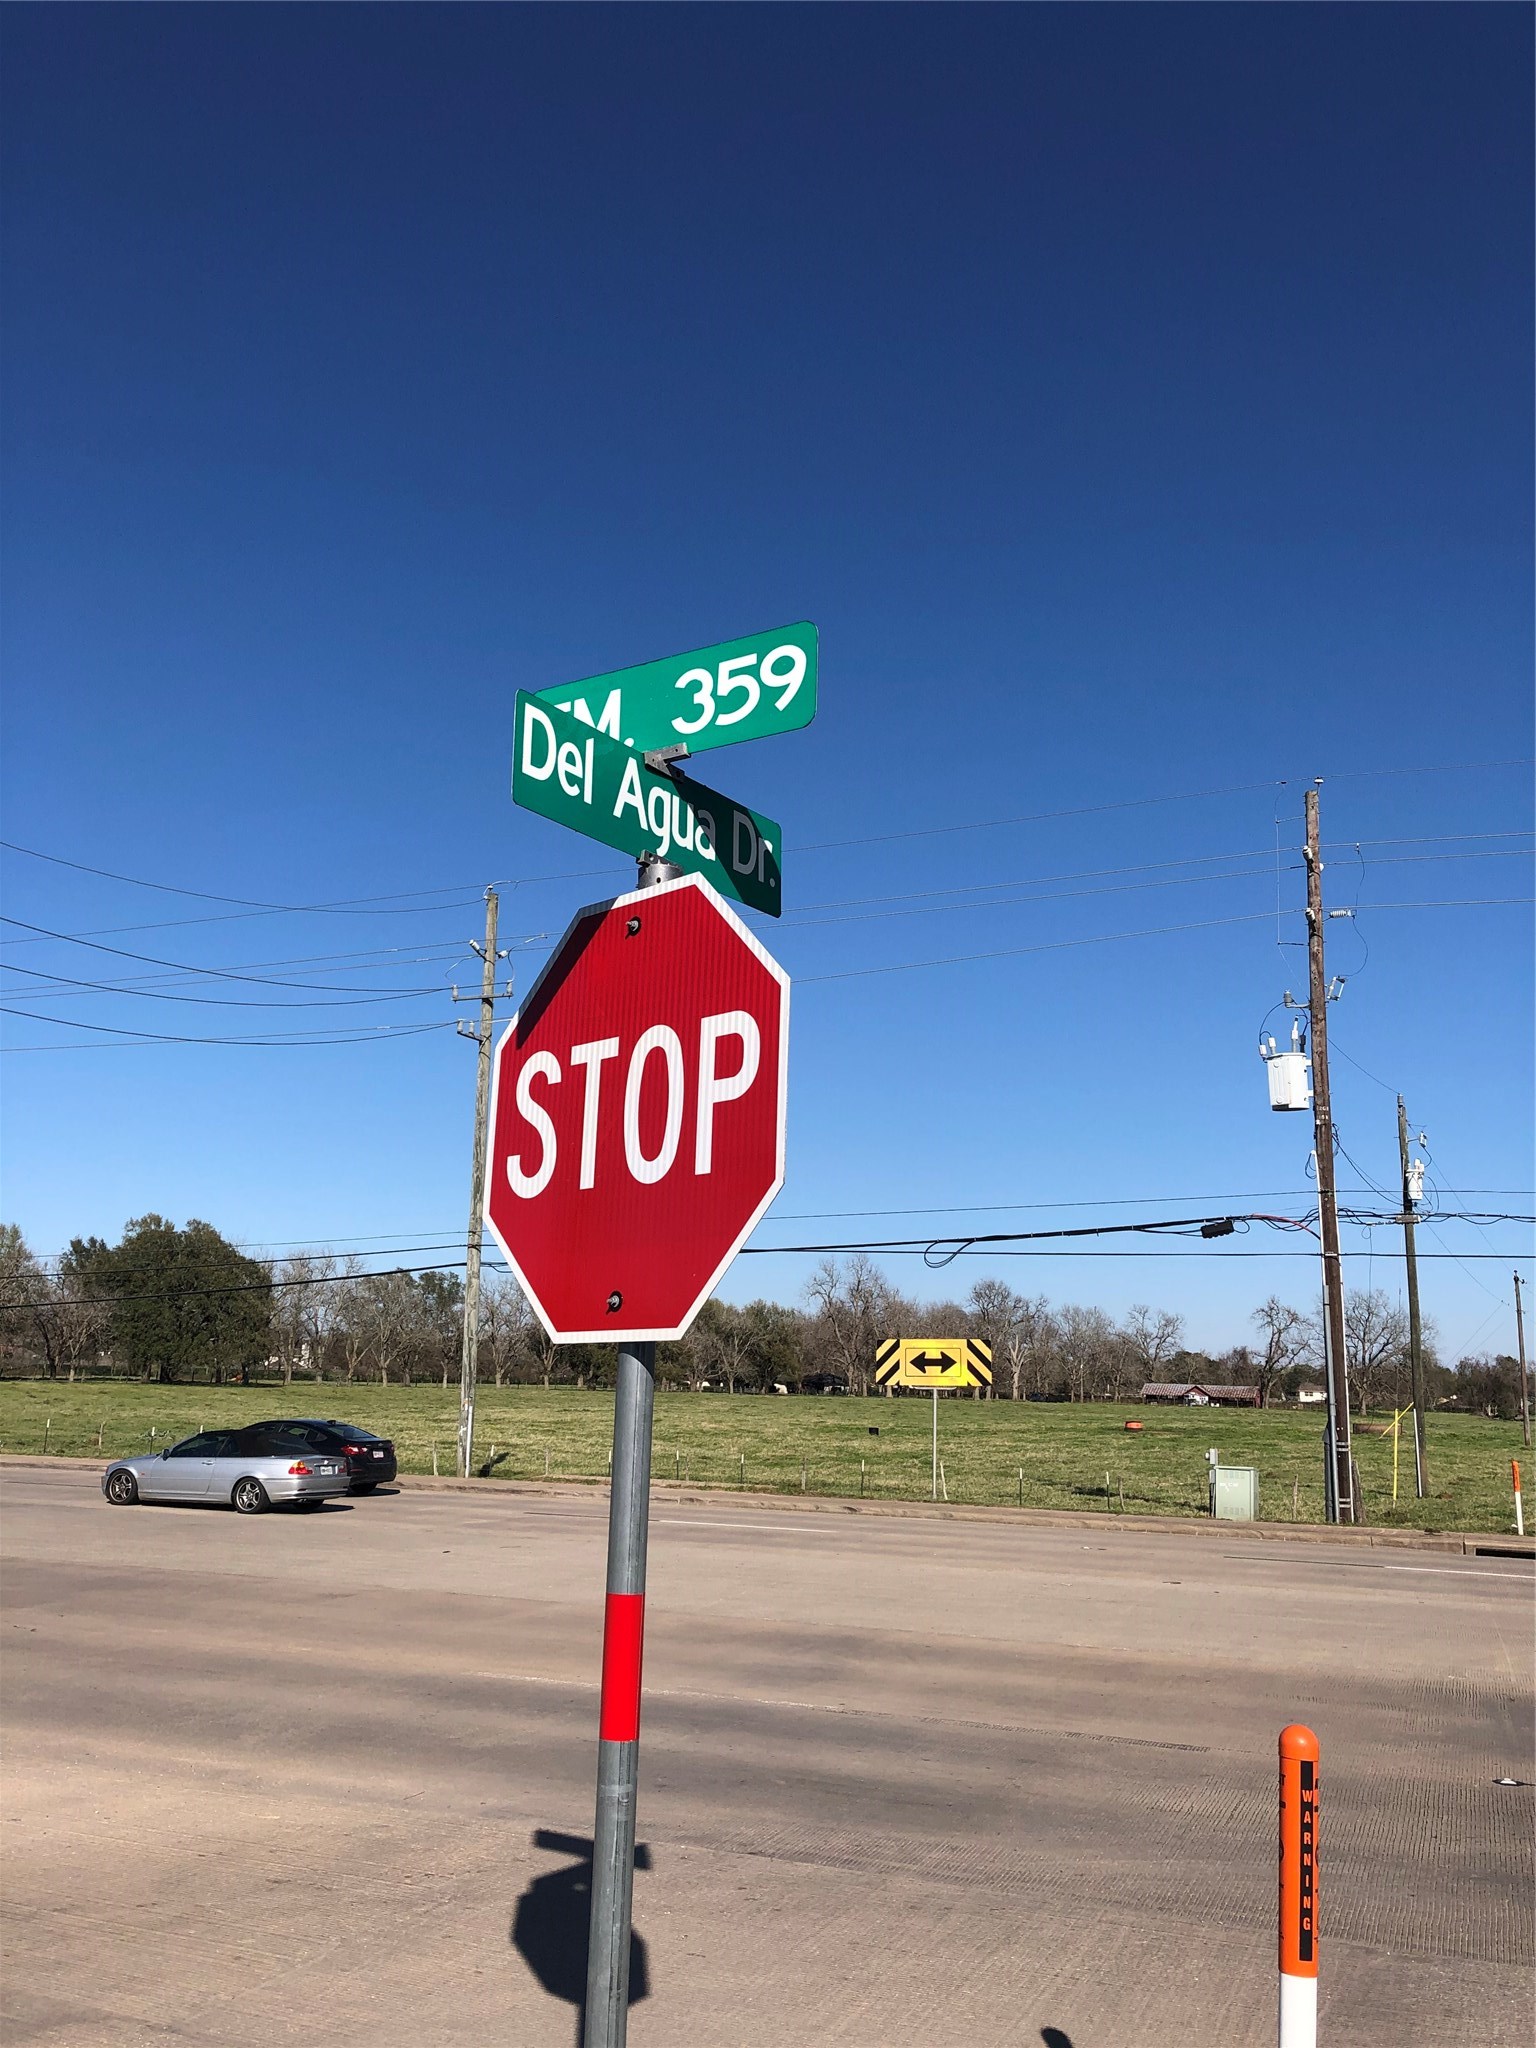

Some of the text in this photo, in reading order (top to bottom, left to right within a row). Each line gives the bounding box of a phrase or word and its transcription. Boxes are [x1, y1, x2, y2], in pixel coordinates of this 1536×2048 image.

[554, 644, 807, 748] M. 359
[522, 702, 776, 888] Del Agua Dr.
[506, 1009, 761, 1200] STOP
[1301, 1789, 1314, 1931] WARNING
